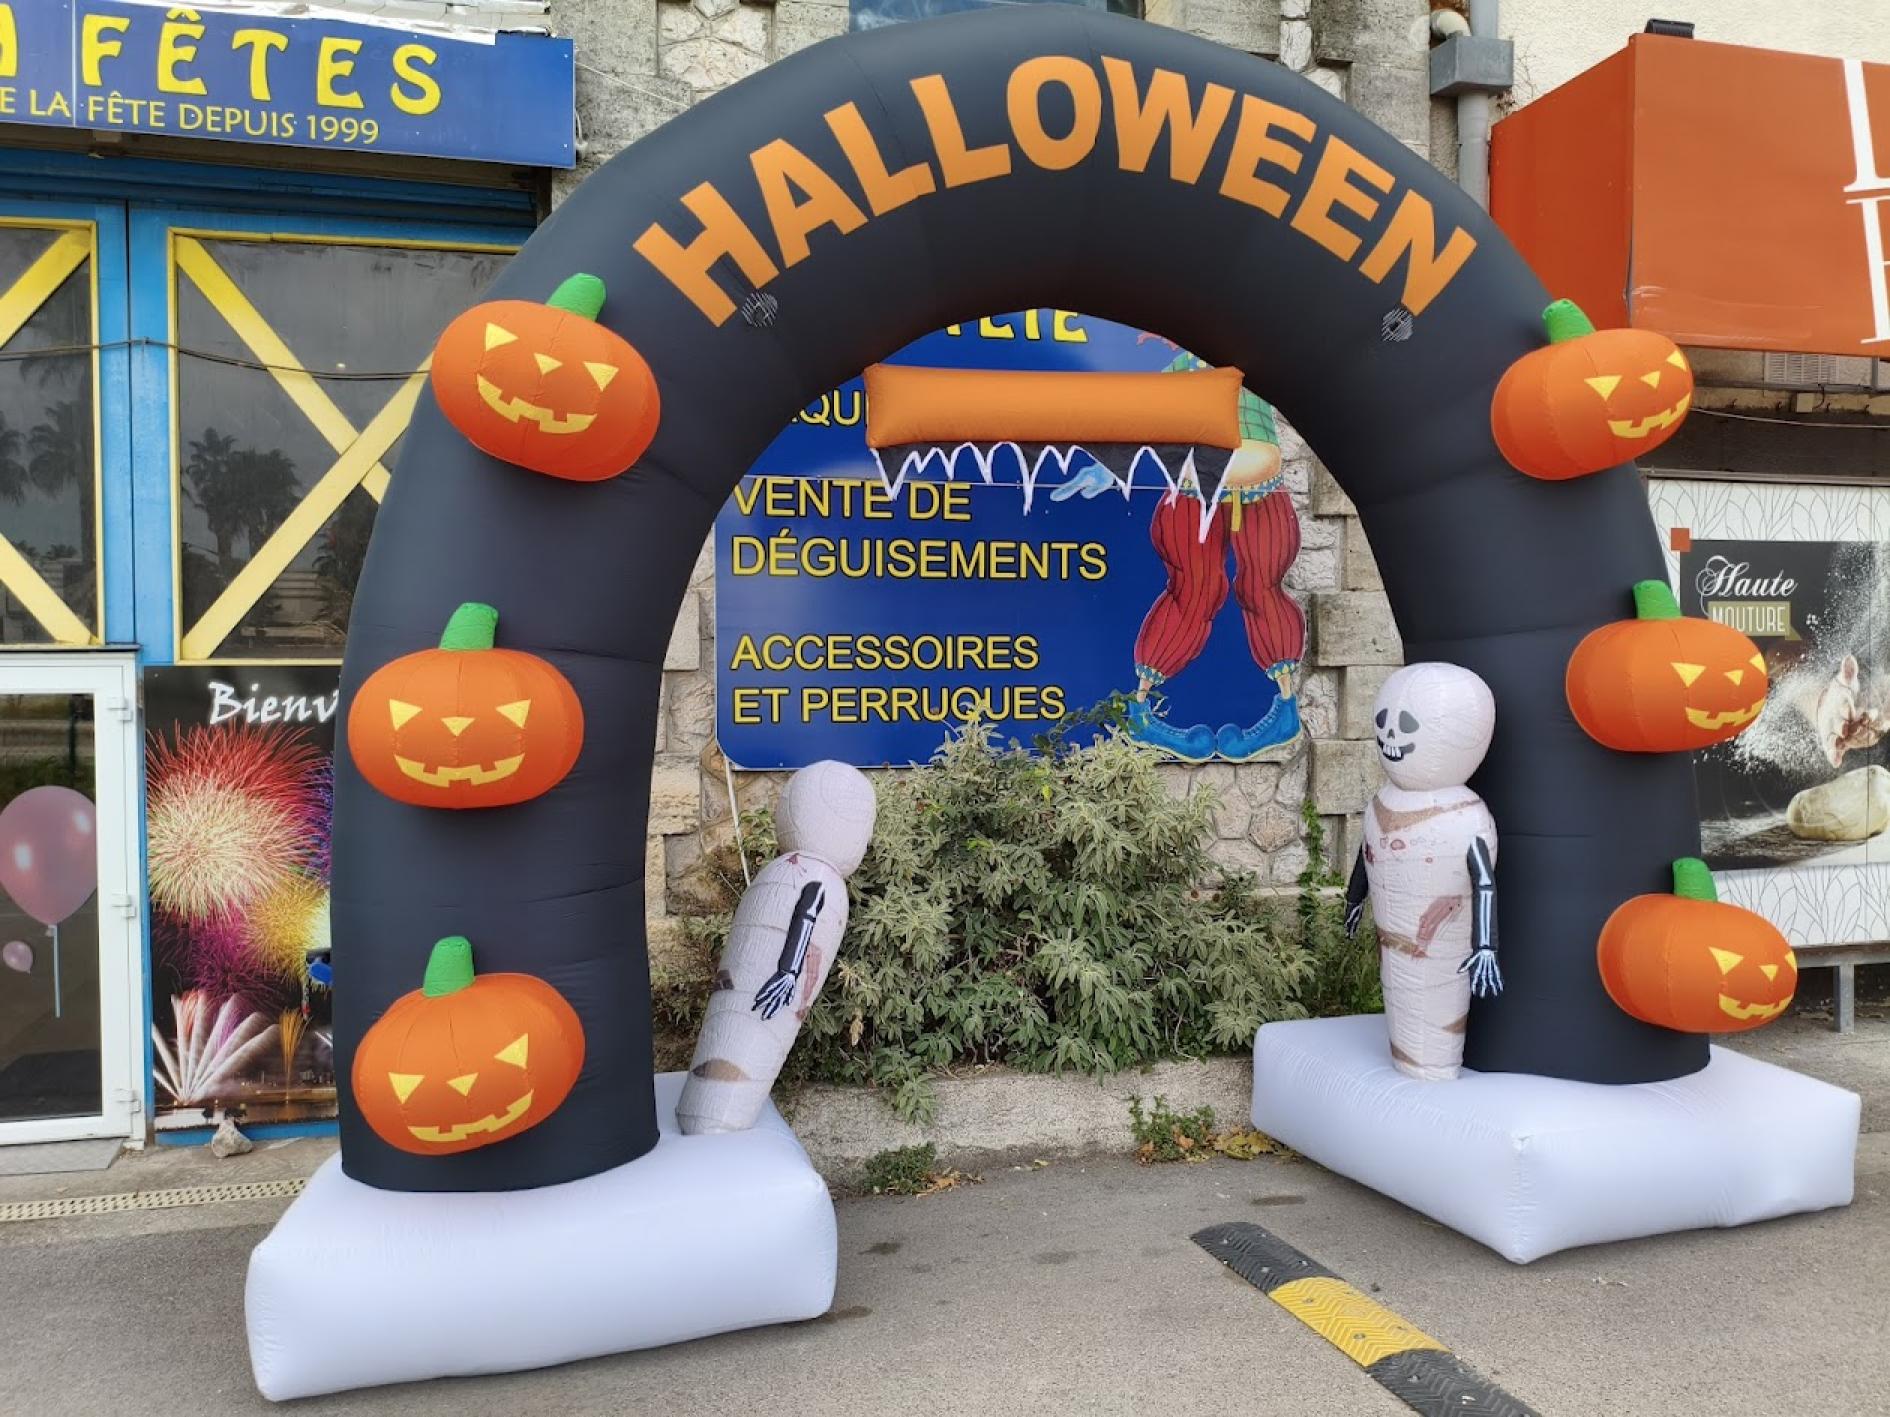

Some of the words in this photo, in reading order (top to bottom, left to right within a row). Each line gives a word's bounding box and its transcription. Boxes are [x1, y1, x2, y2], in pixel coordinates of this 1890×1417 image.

[82, 8, 441, 115] FÊTES
[29, 89, 72, 118] LA
[87, 90, 166, 127] FÊTE
[178, 103, 295, 137] DEPUIS
[307, 115, 380, 145] 1999
[633, 55, 1478, 328] HALLOWEEN
[733, 477, 893, 519] VENTE
[909, 481, 972, 521] DE
[731, 528, 1108, 580] DÉGUISEMENTS
[1695, 555, 1799, 598] Haute
[1712, 606, 1786, 633] MOUTURE
[730, 634, 1040, 670] ACCESSOIRES
[733, 687, 790, 724] ET
[801, 686, 1067, 723] PERRUQUES
